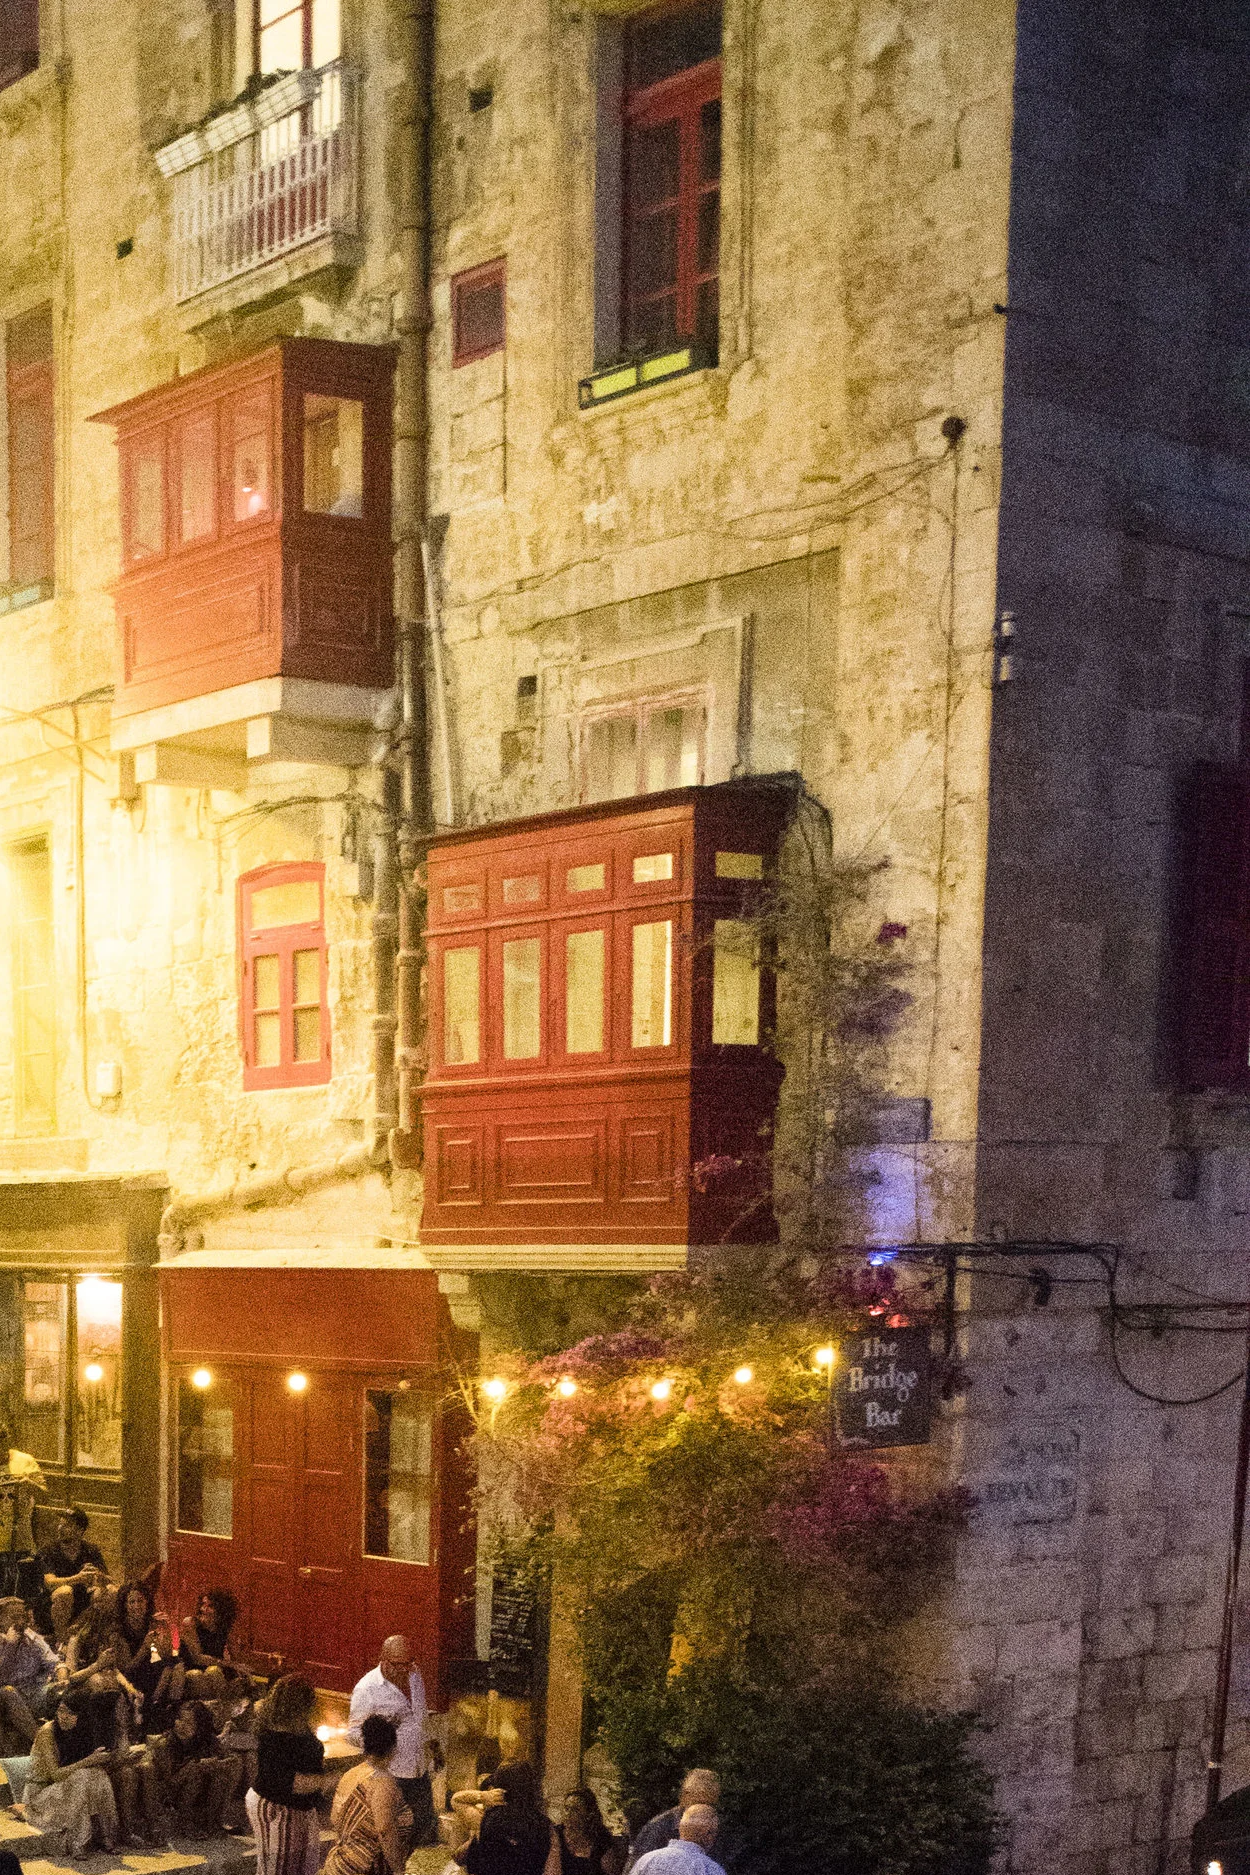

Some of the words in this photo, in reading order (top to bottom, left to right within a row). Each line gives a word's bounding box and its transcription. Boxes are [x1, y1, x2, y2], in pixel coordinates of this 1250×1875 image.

[861, 1337, 898, 1359] The
[849, 1363, 919, 1402] Bridge
[865, 1401, 902, 1427] Bar
